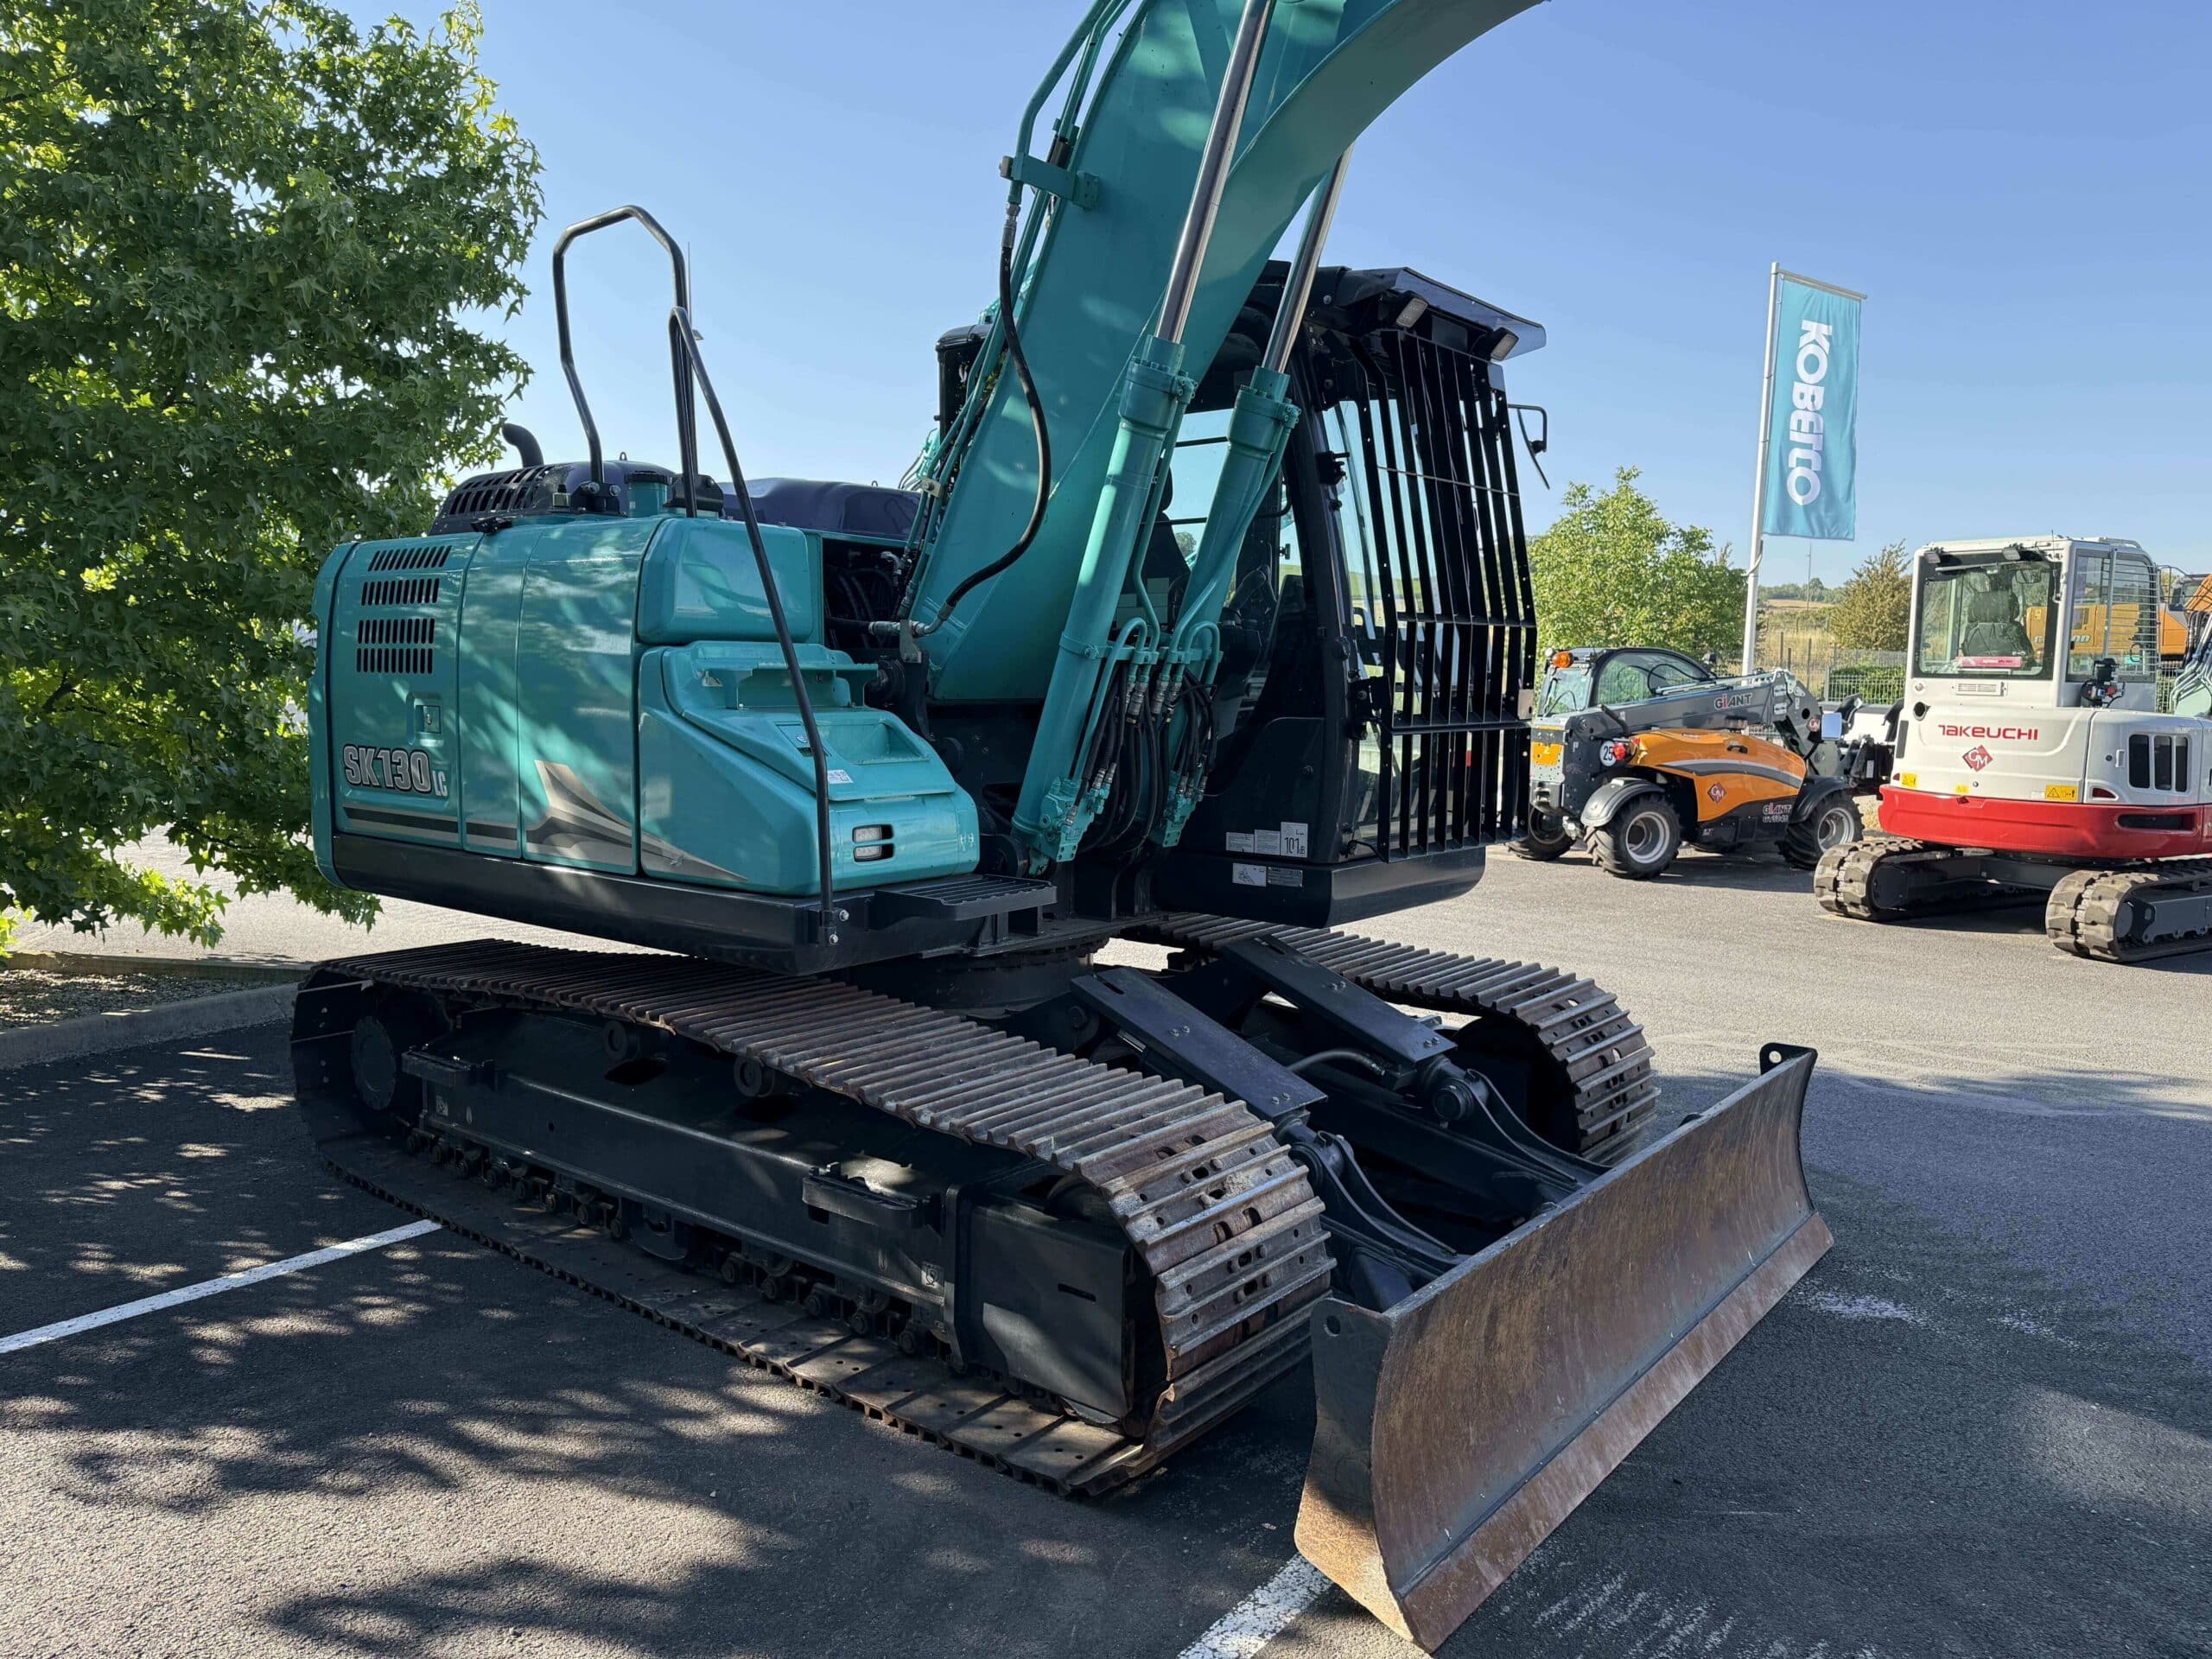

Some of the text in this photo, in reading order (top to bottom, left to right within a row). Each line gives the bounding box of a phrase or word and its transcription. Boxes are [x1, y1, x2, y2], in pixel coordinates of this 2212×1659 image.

[1938, 724, 2038, 741] TAKEUCHI
[343, 744, 448, 797] SK130 LC
[1284, 836, 1300, 855] 101
